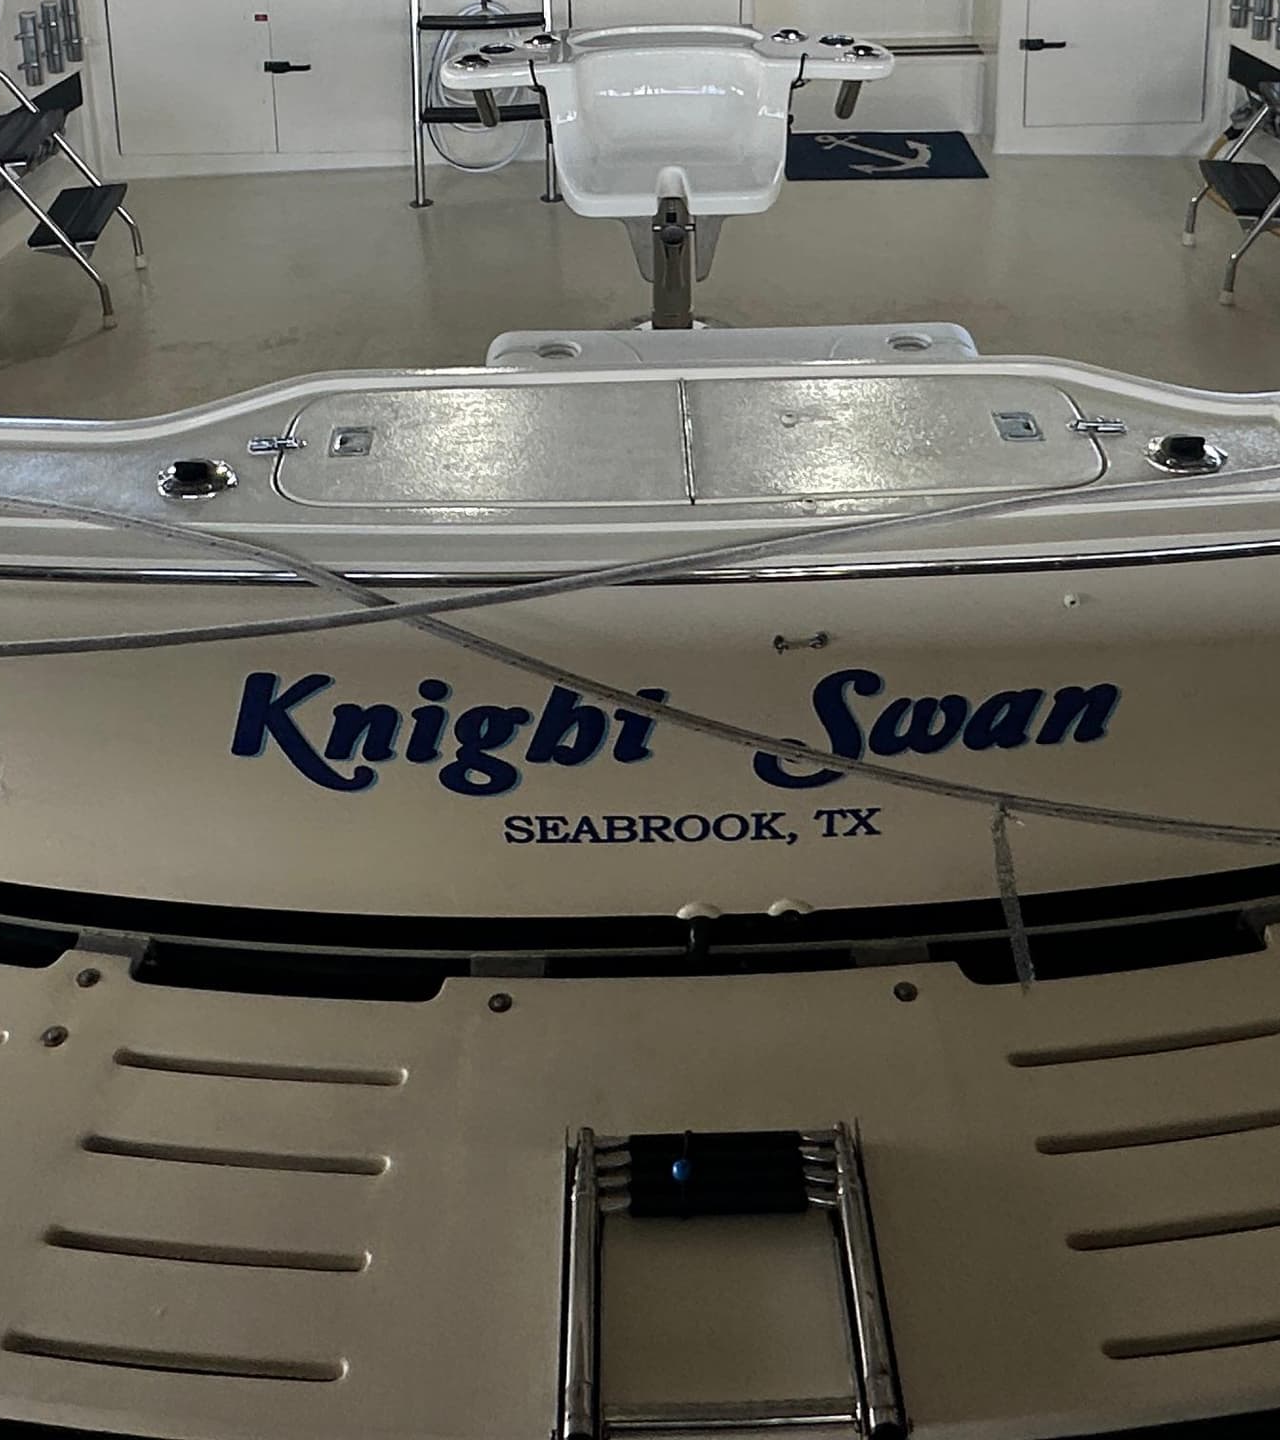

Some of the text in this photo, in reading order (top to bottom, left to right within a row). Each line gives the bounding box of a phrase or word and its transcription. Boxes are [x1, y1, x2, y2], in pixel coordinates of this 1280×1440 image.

[231, 669, 1120, 796] Knight Swan
[504, 808, 881, 845] SEABROOK, TX
